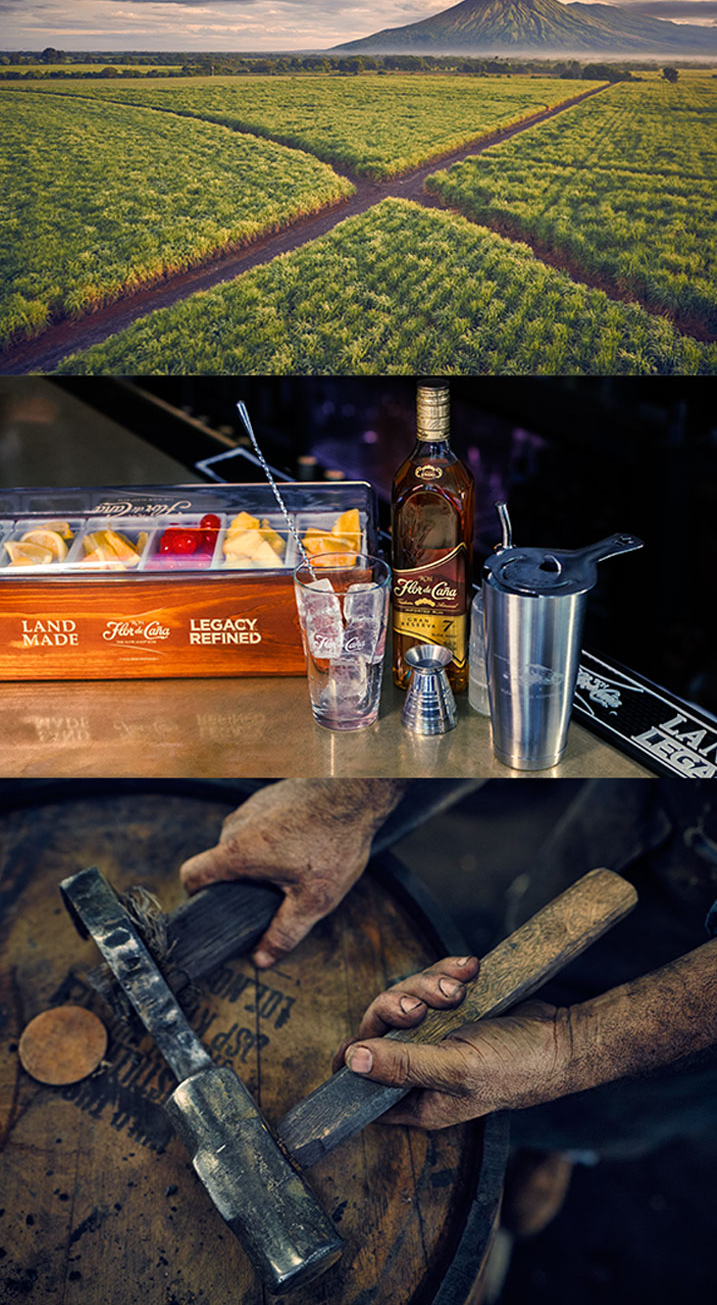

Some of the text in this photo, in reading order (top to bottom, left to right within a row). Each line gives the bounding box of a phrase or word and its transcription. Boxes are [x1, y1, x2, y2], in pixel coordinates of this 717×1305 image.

[394, 578, 422, 596] Flor
[432, 582, 457, 600] Caña
[22, 620, 75, 632] LAND
[103, 622, 134, 640] Flor
[190, 619, 257, 631] LEGACY
[443, 620, 454, 632] 7
[22, 634, 79, 646] MADE
[190, 632, 261, 645] REFINED
